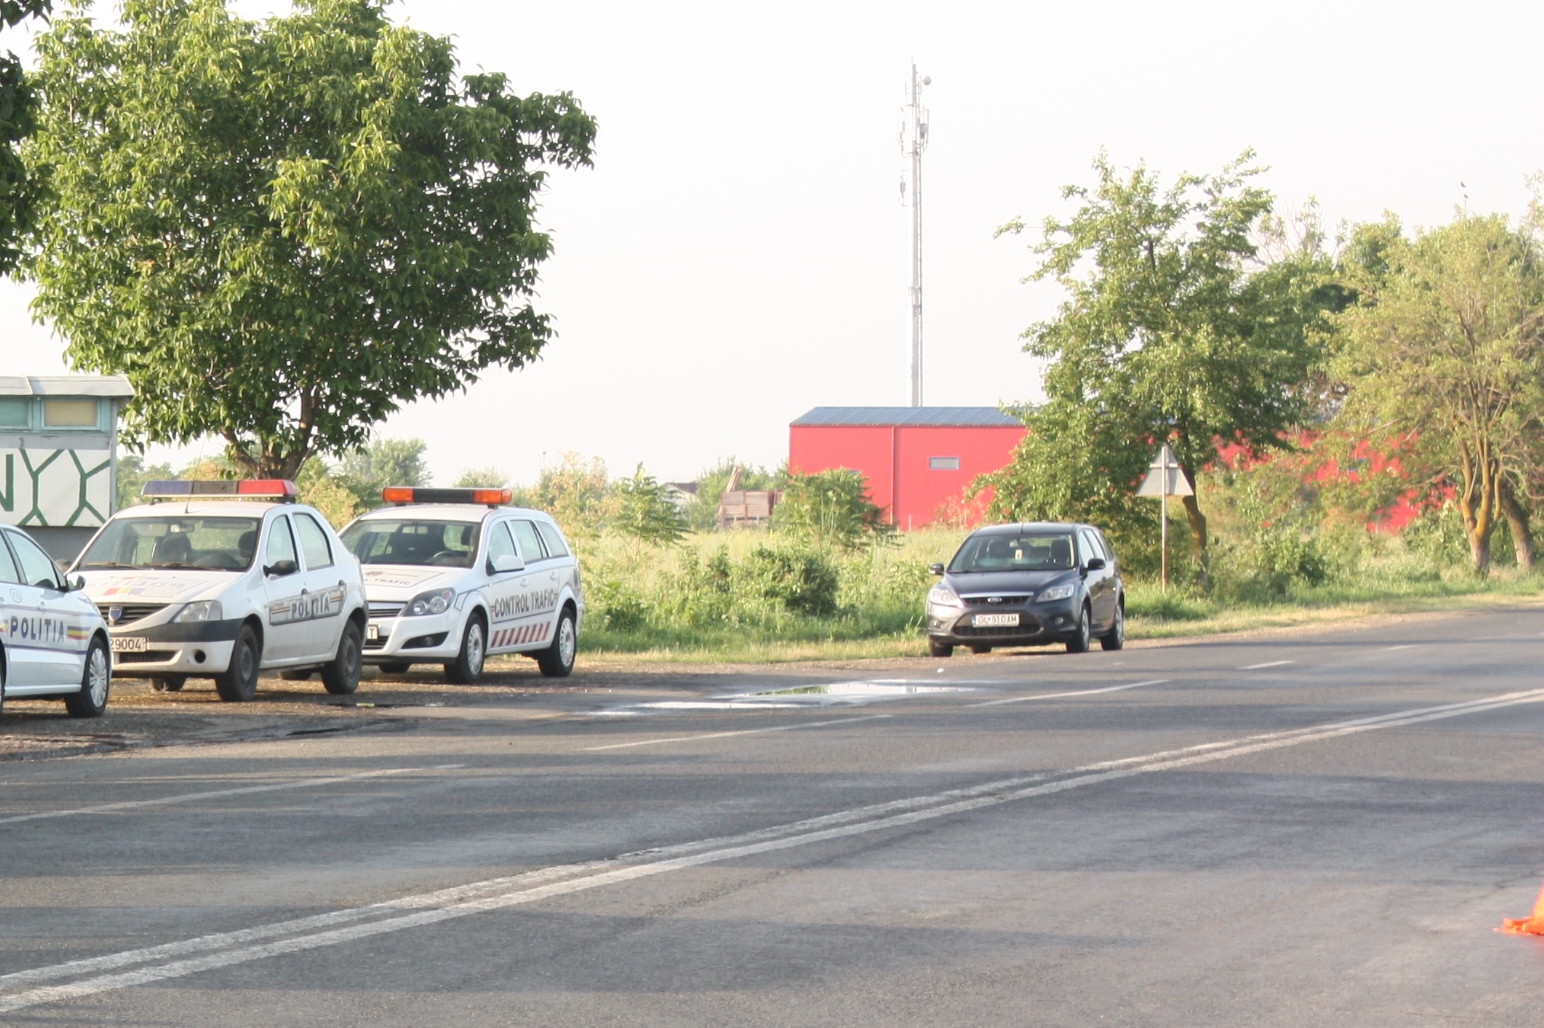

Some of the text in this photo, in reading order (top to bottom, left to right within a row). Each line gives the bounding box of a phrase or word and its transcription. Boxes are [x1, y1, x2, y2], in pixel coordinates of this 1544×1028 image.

[292, 597, 330, 619] POLITIA
[494, 588, 554, 618] CONTROL TRAFIC
[10, 615, 65, 643] POLITIA
